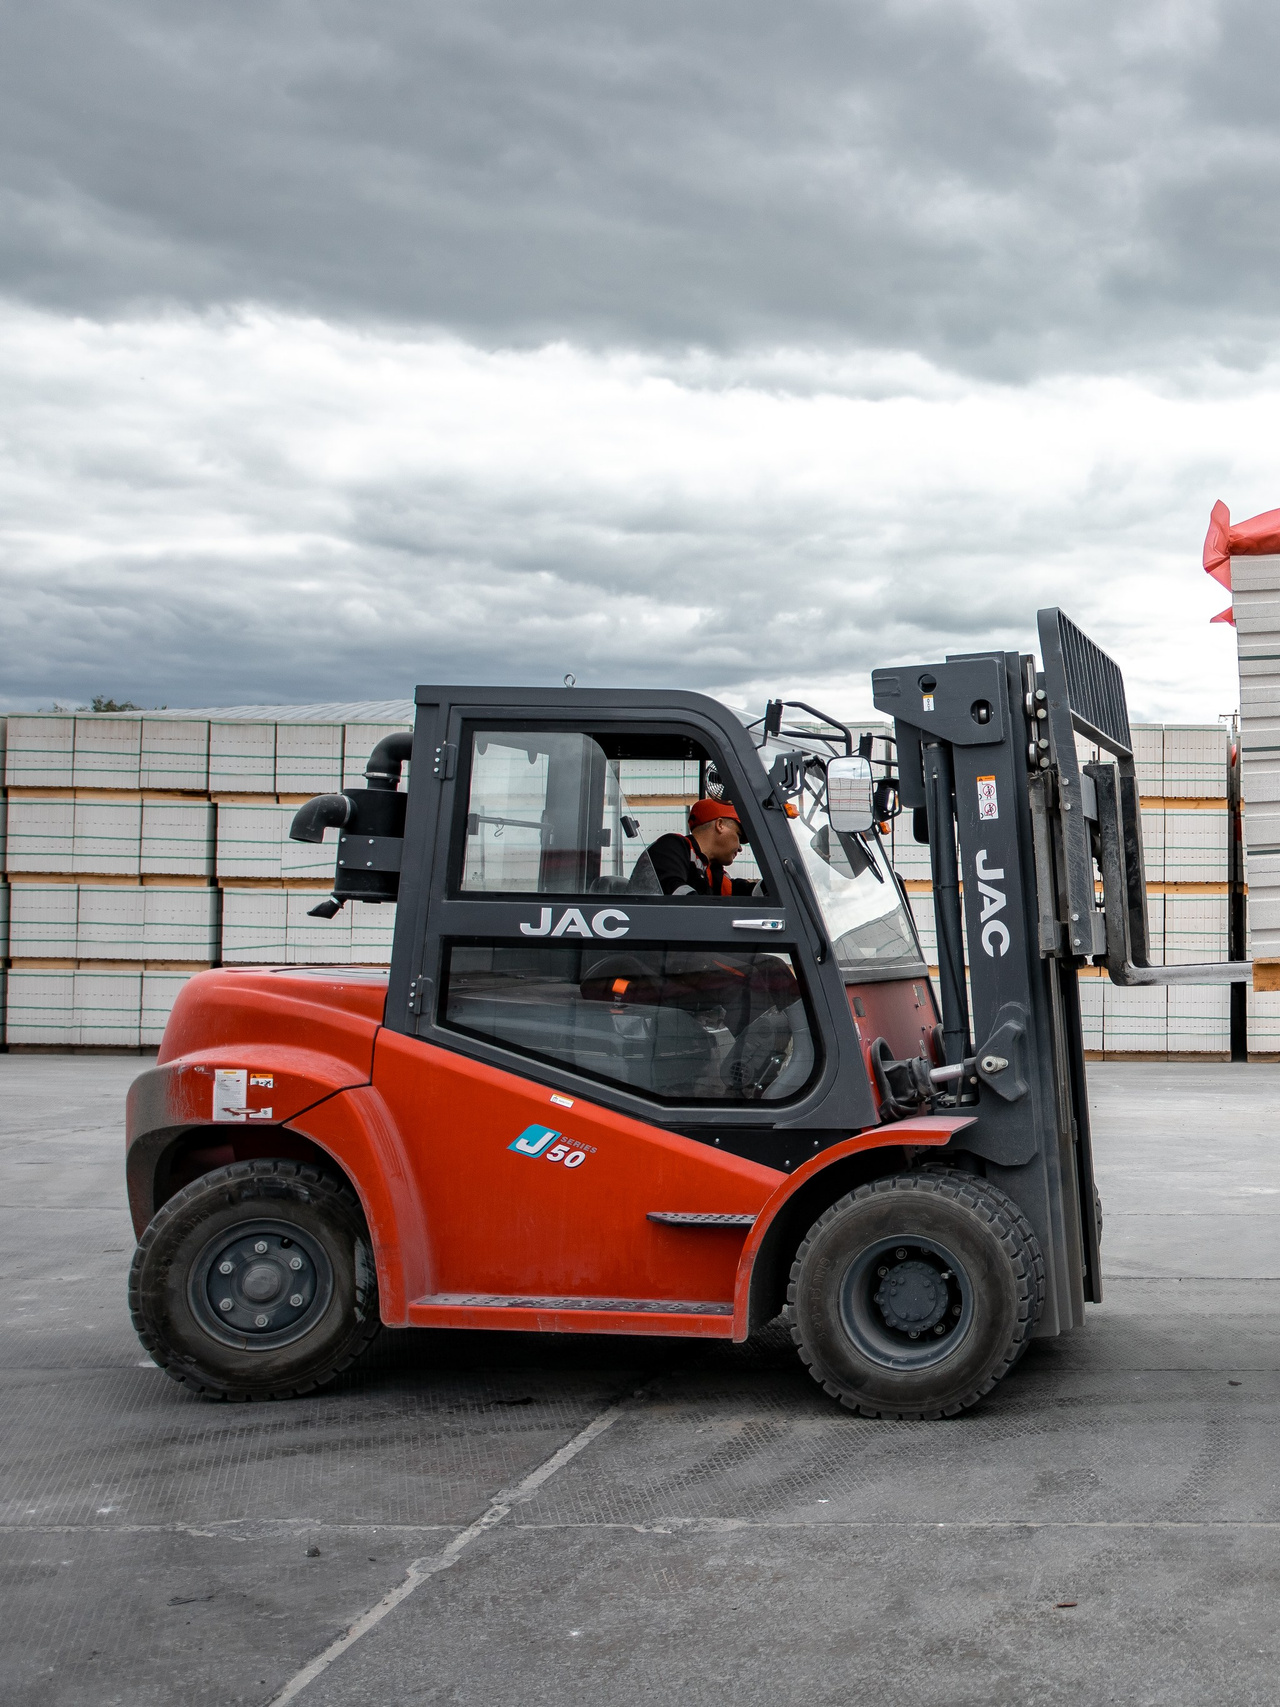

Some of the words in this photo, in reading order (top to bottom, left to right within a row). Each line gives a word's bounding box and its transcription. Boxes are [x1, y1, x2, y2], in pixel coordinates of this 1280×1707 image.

[975, 849, 1011, 958] JAC
[519, 907, 630, 938] JAC
[515, 1131, 557, 1155] J
[560, 1136, 598, 1154] SERIES
[546, 1144, 586, 1169] 50
